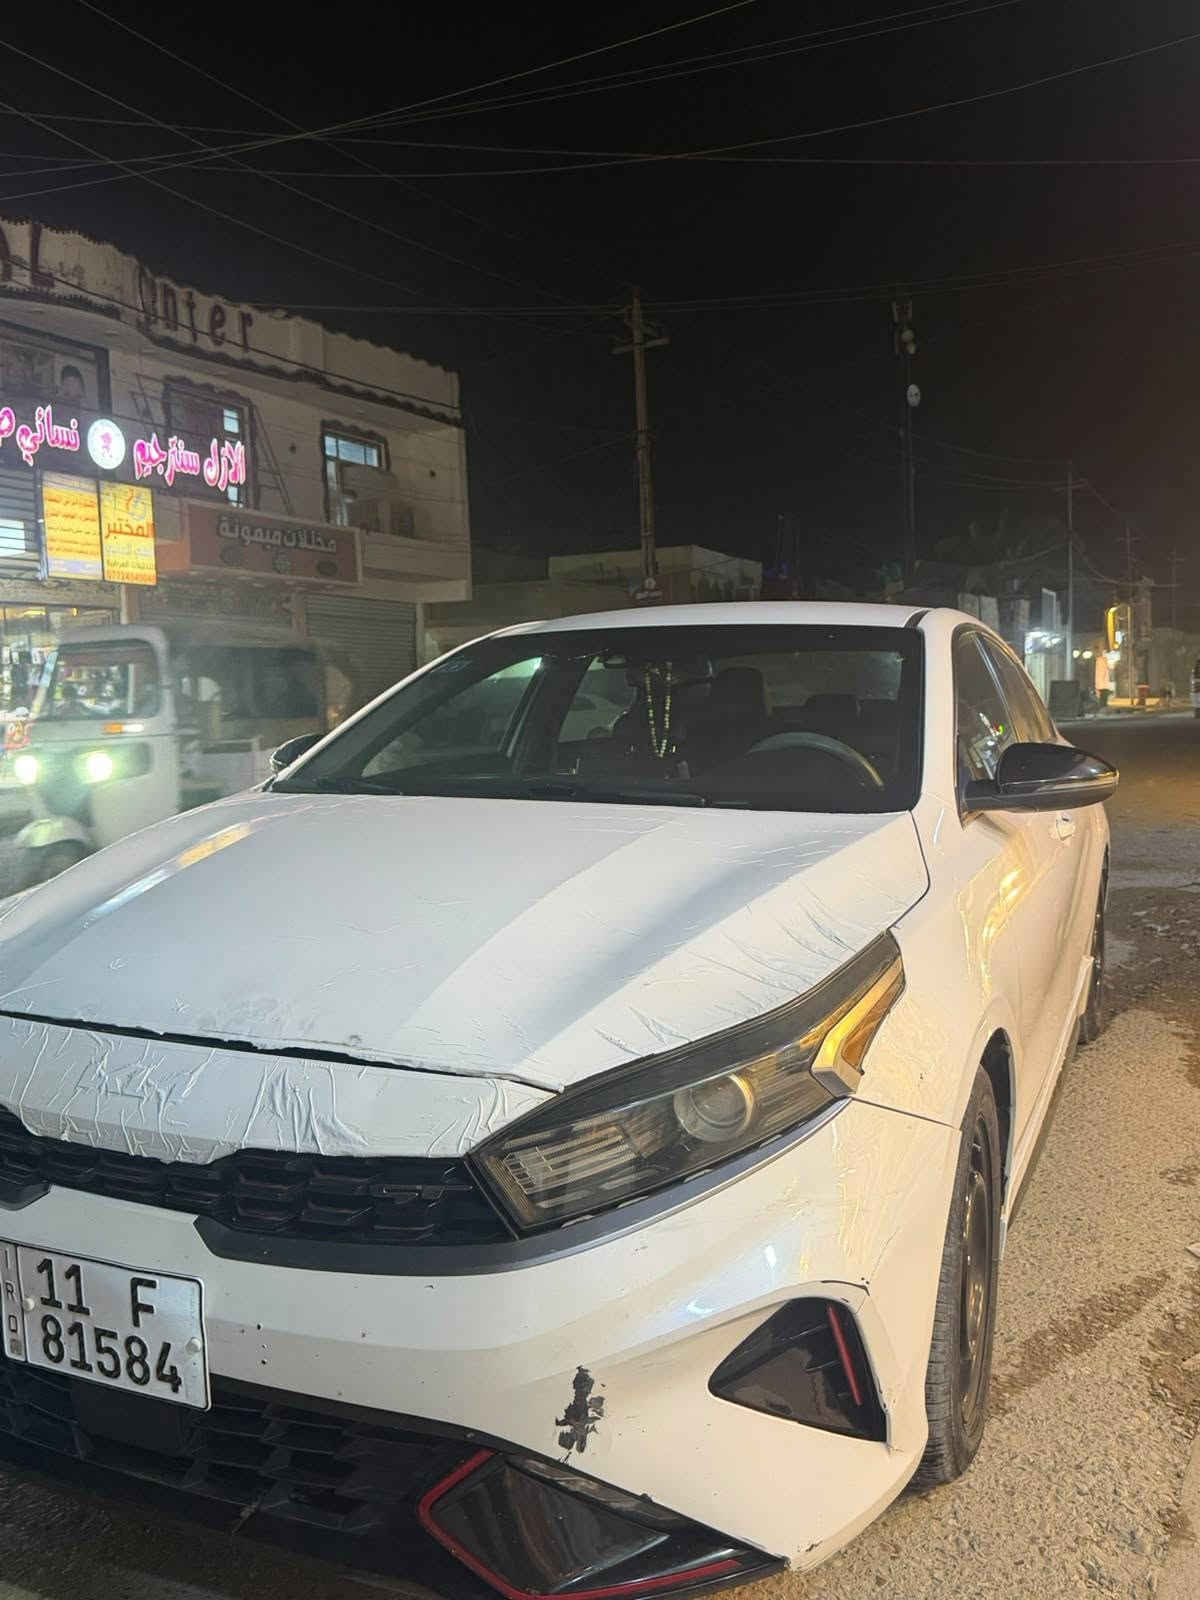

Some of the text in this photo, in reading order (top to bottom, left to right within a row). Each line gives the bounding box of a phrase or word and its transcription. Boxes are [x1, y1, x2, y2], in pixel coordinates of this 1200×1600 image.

[16, 404, 81, 467] نسائي
[36, 1257, 158, 1327] 11 F
[40, 1313, 183, 1394] 81584
